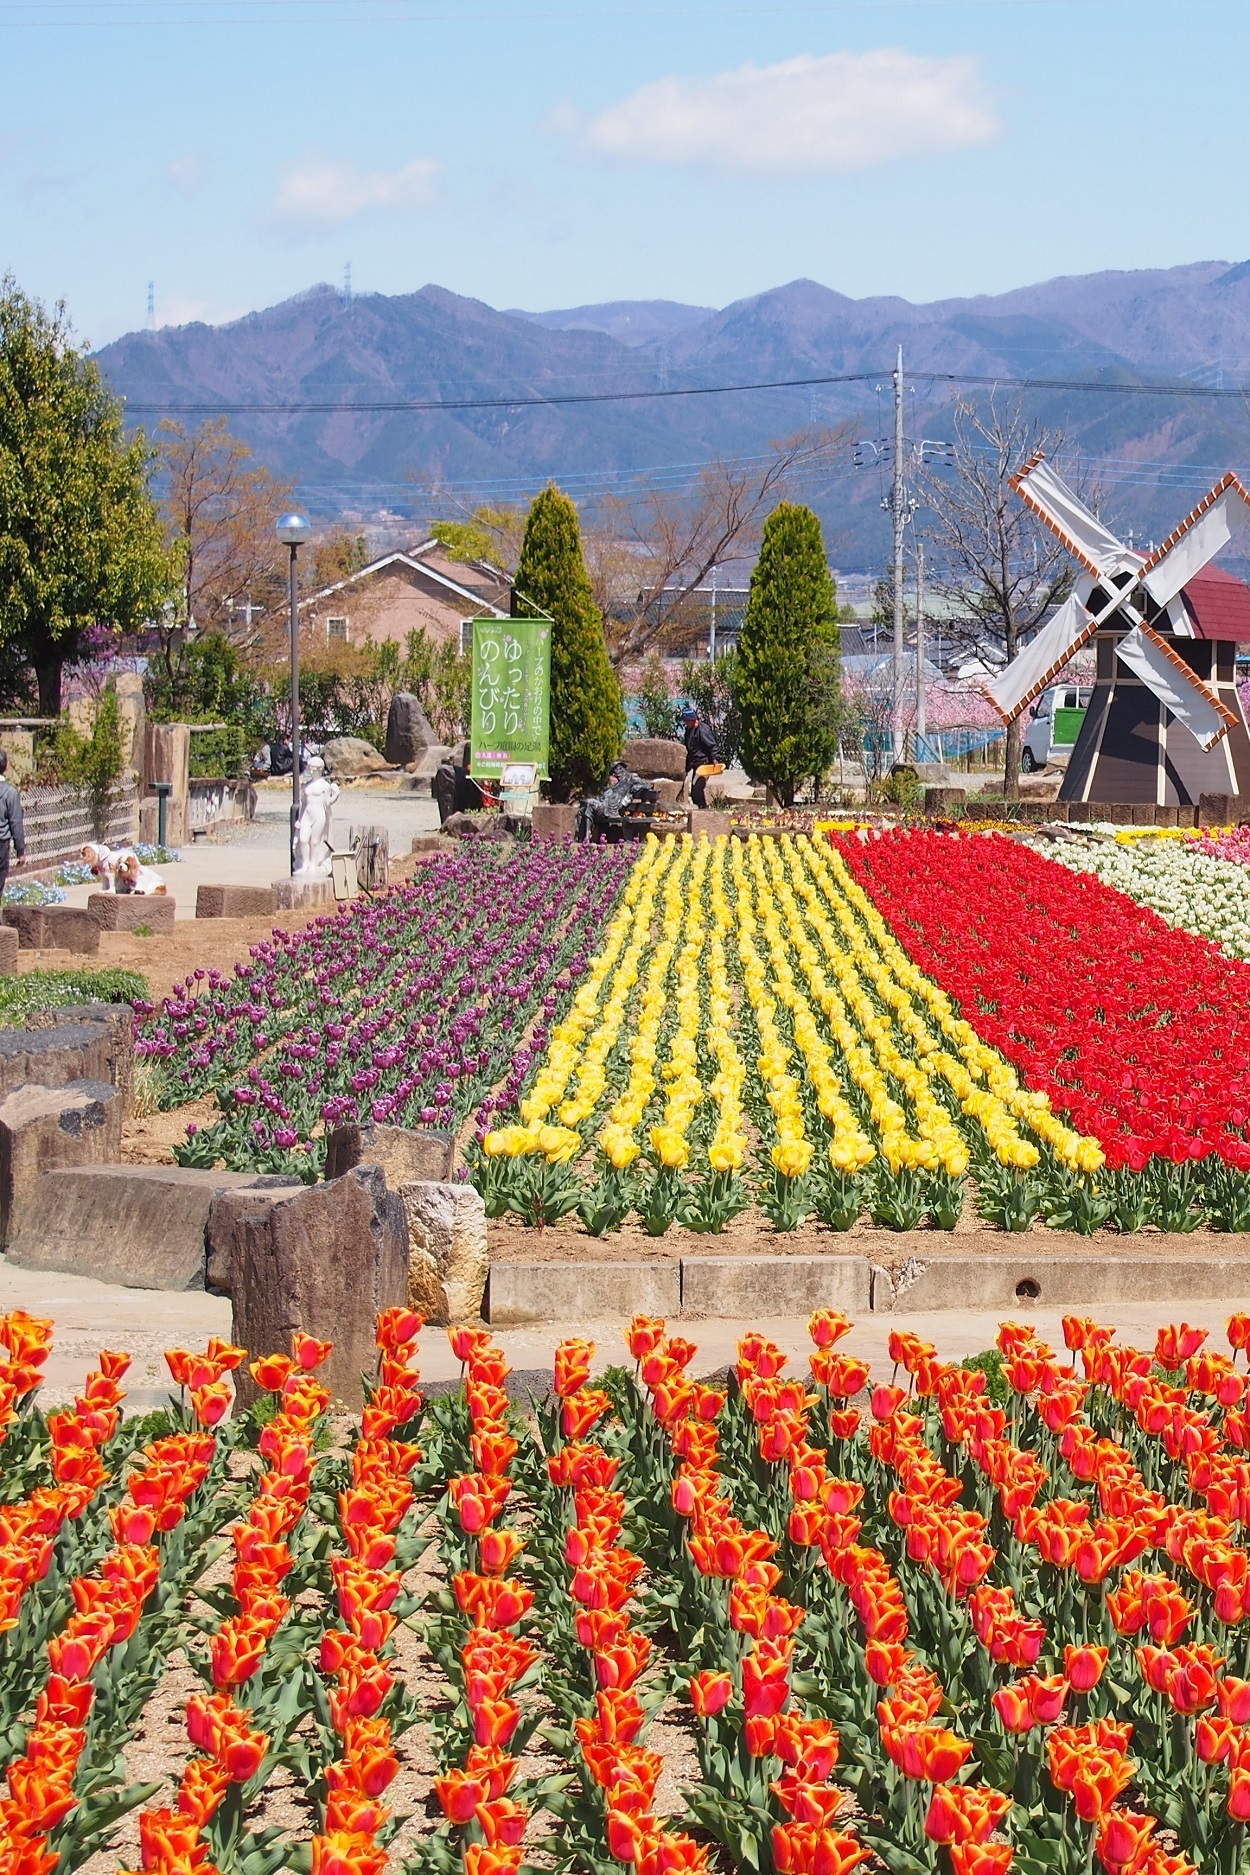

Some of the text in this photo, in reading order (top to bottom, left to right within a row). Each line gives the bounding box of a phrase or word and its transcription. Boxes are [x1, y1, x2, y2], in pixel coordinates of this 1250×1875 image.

[479, 640, 500, 735] のんびり
[503, 638, 522, 735] ゆったり
